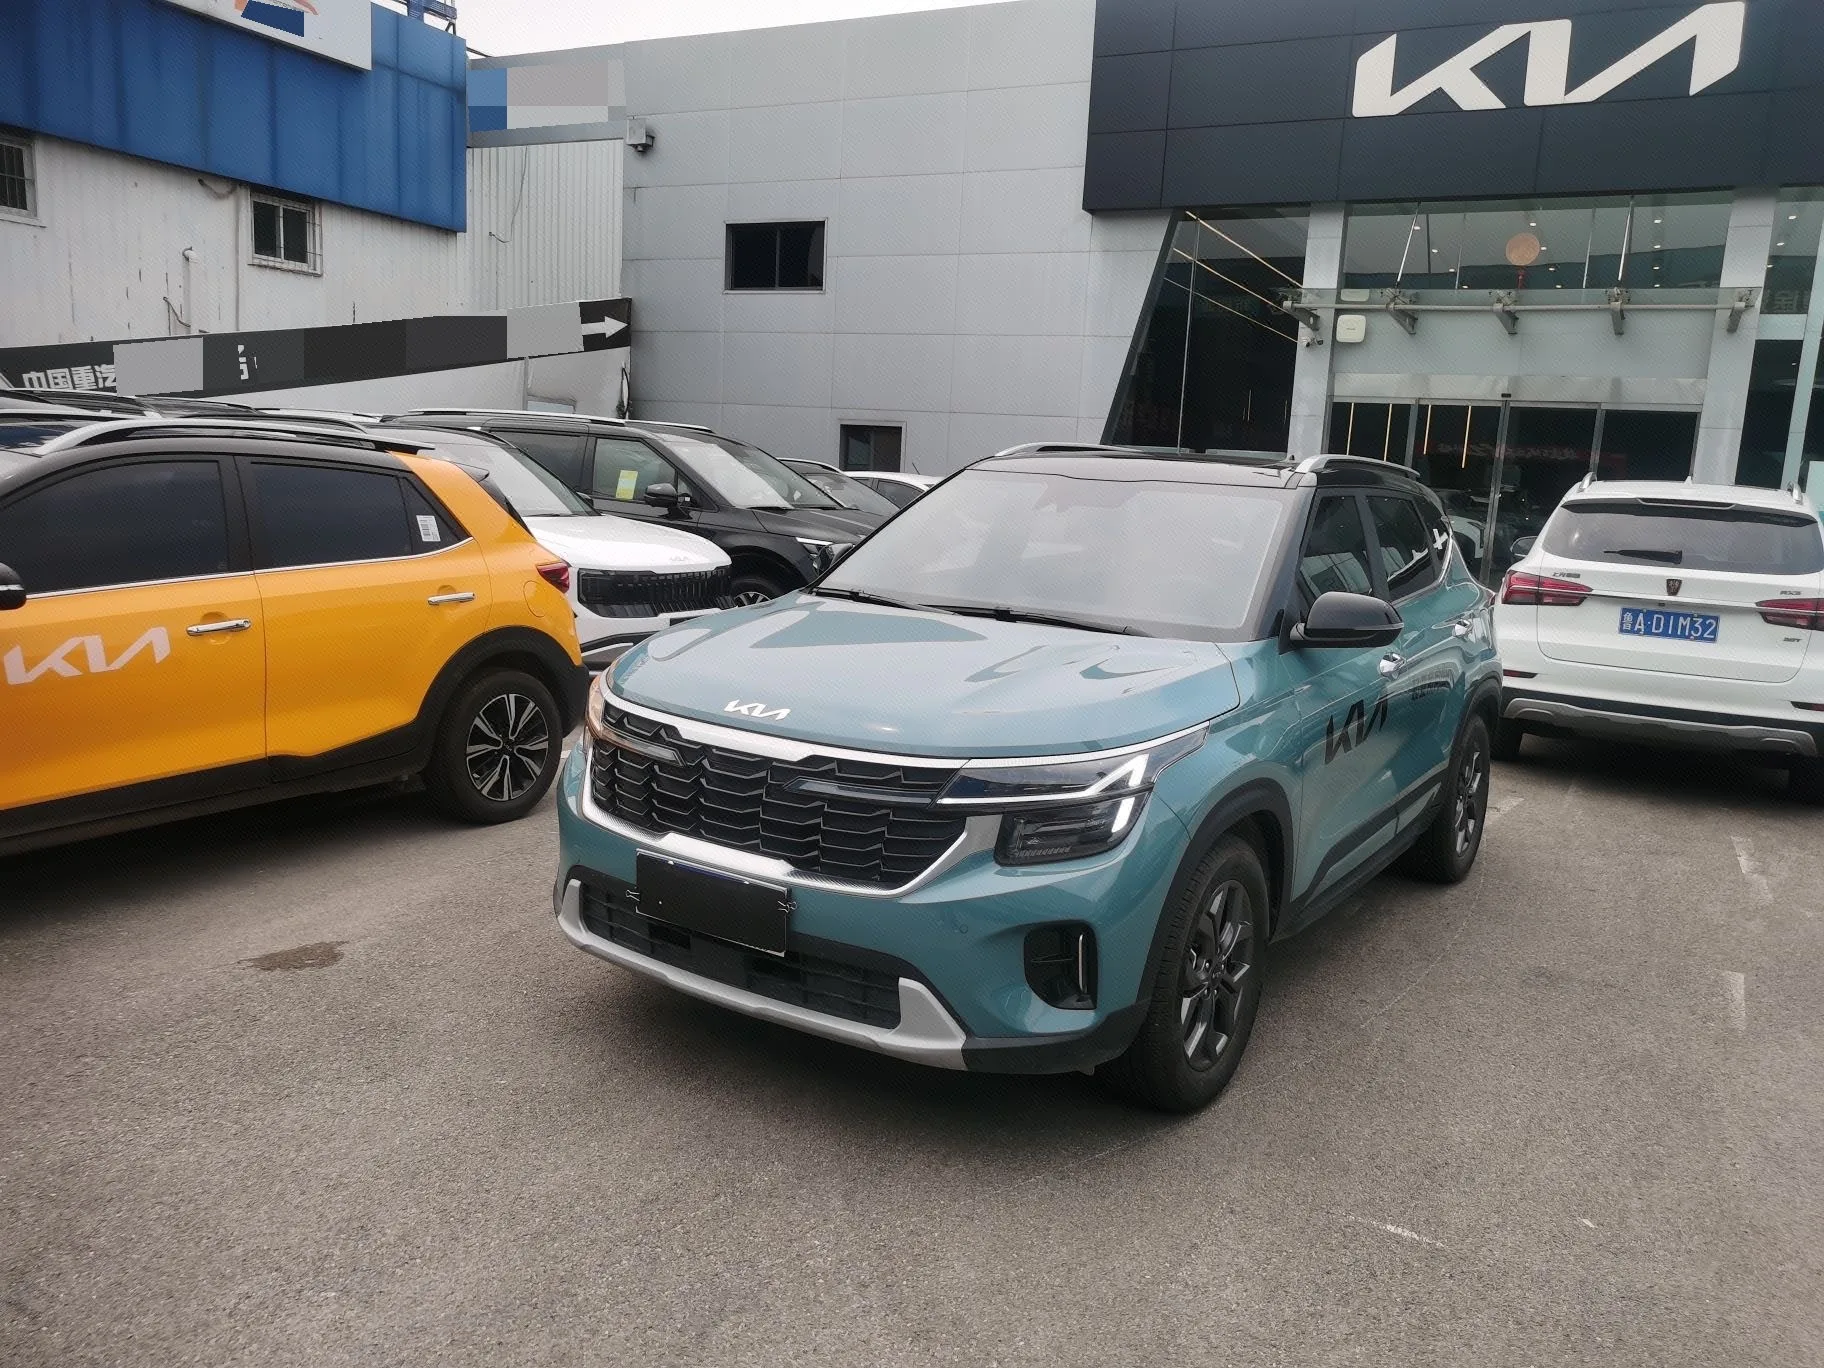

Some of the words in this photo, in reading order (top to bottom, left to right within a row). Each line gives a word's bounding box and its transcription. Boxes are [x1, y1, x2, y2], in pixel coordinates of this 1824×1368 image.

[1352, 1, 1745, 117] KIA
[3, 626, 171, 686] KIA
[724, 699, 791, 721] KIA
[1324, 693, 1388, 766] KIA
